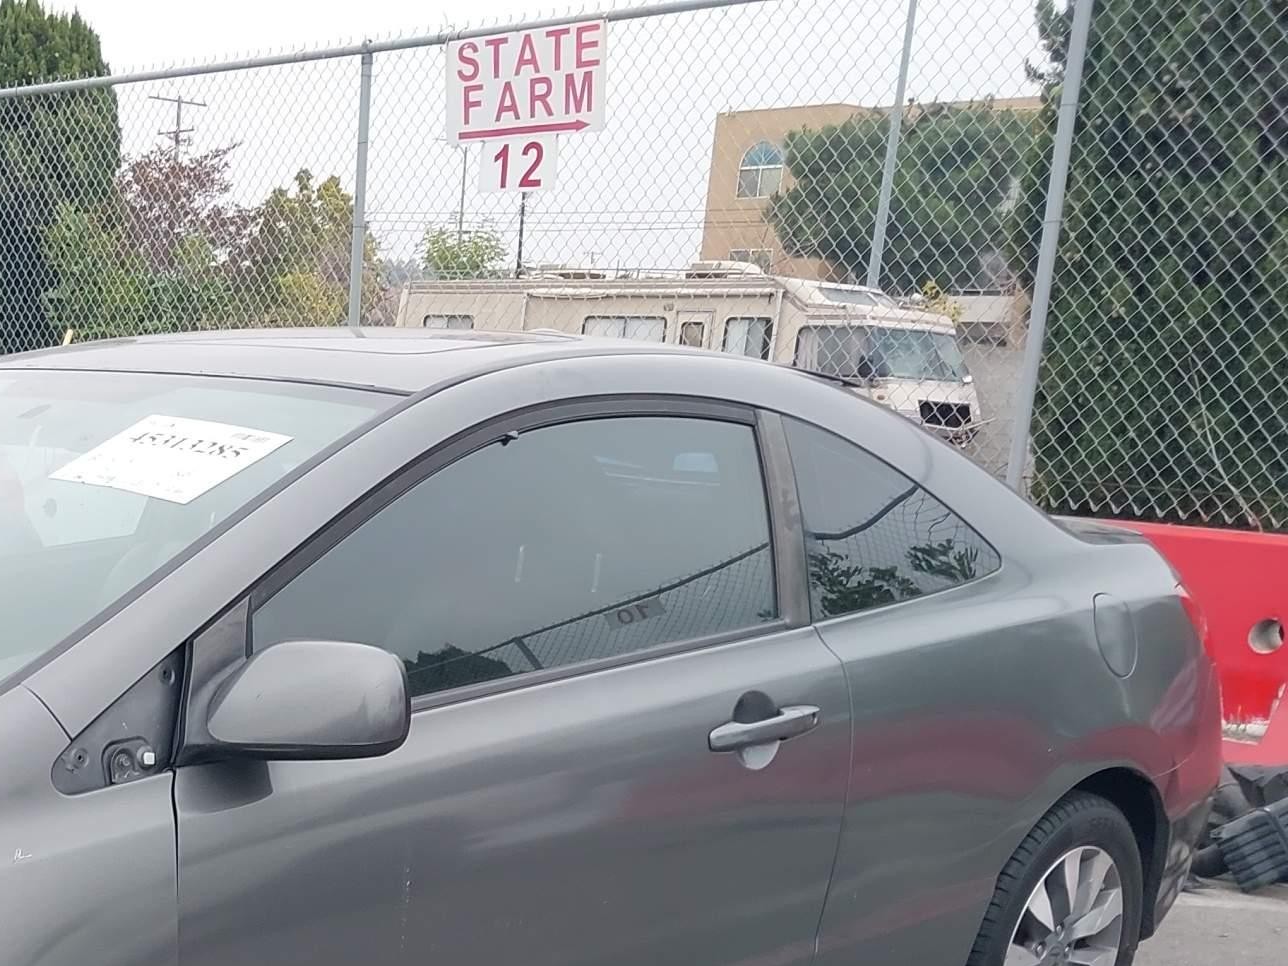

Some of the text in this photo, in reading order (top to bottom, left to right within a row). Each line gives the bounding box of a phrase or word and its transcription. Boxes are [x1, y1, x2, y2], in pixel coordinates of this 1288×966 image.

[457, 23, 601, 83] STATE
[463, 70, 594, 126] FARM
[494, 141, 544, 189] 12
